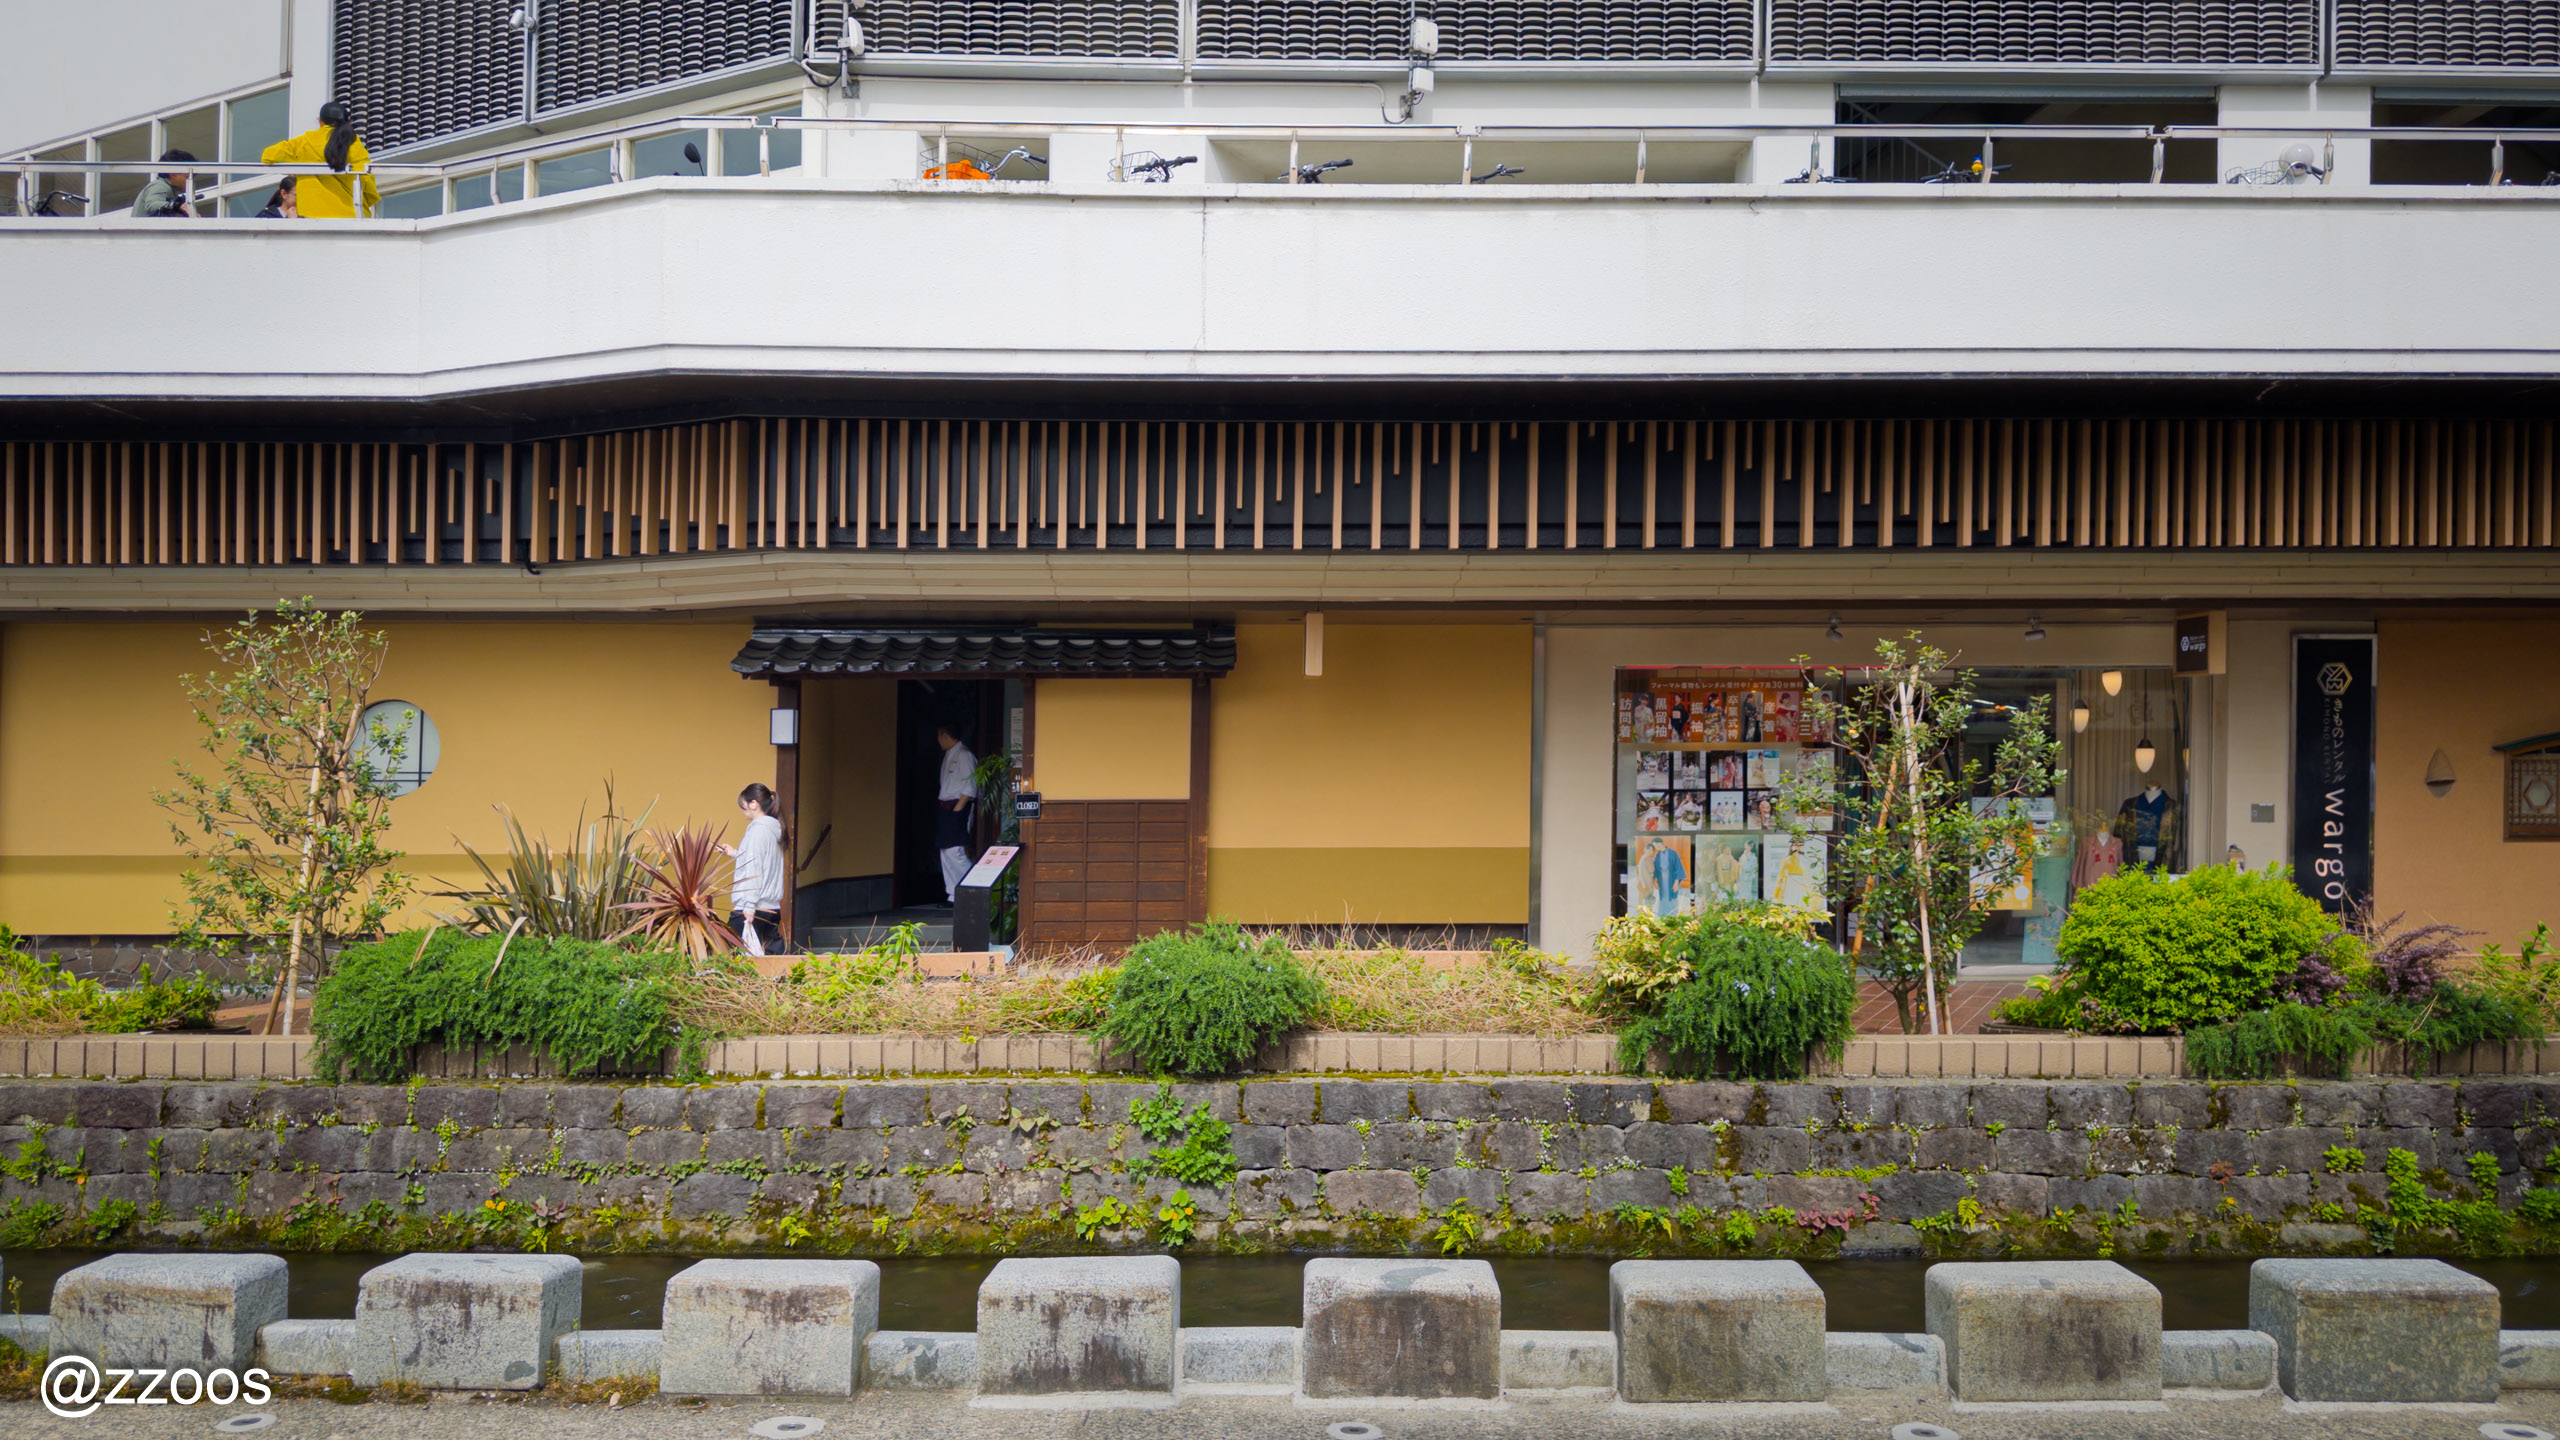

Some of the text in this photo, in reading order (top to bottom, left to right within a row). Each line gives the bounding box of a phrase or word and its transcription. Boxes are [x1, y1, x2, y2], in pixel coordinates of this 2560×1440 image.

[1619, 698, 1632, 738] 訪問着
[1655, 697, 1668, 737] 黒留袖
[1691, 702, 1704, 733] 振袖
[1727, 696, 1739, 740] 卒業式袴
[1763, 702, 1776, 733] 産着
[2322, 697, 2331, 740] KIMONO
[1016, 801, 1039, 810] CLOSED
[2314, 788, 2345, 900] wargo
